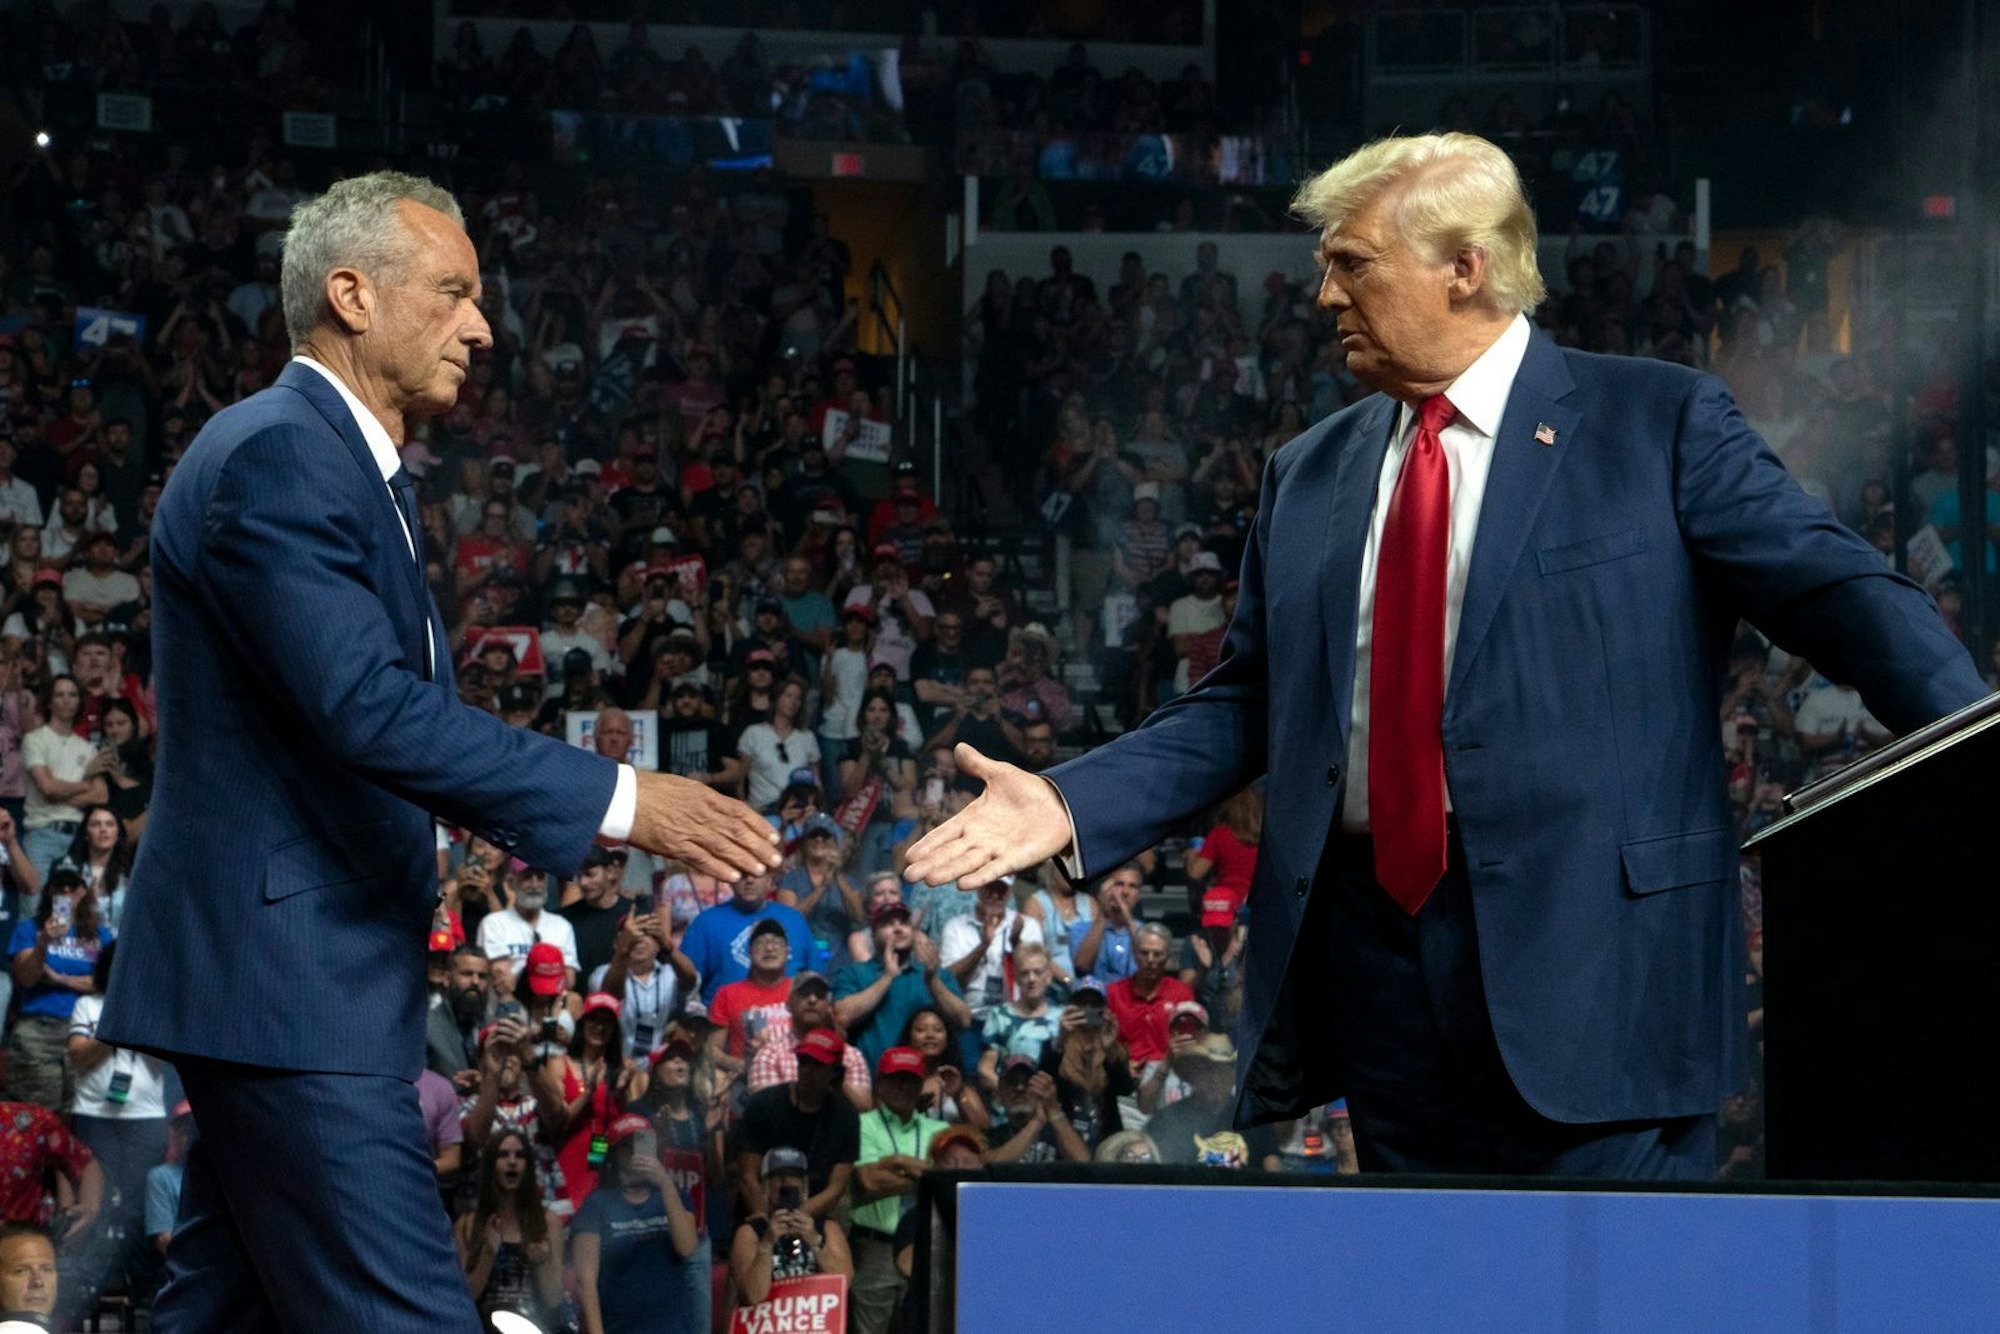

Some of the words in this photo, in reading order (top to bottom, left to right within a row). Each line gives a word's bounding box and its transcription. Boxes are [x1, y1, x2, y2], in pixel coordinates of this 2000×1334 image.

[1579, 151, 1618, 178] 47
[1578, 187, 1620, 217] 47
[1041, 491, 1072, 523] 47
[738, 1293, 840, 1324] TRUMP
[744, 1313, 827, 1334] VANCE
